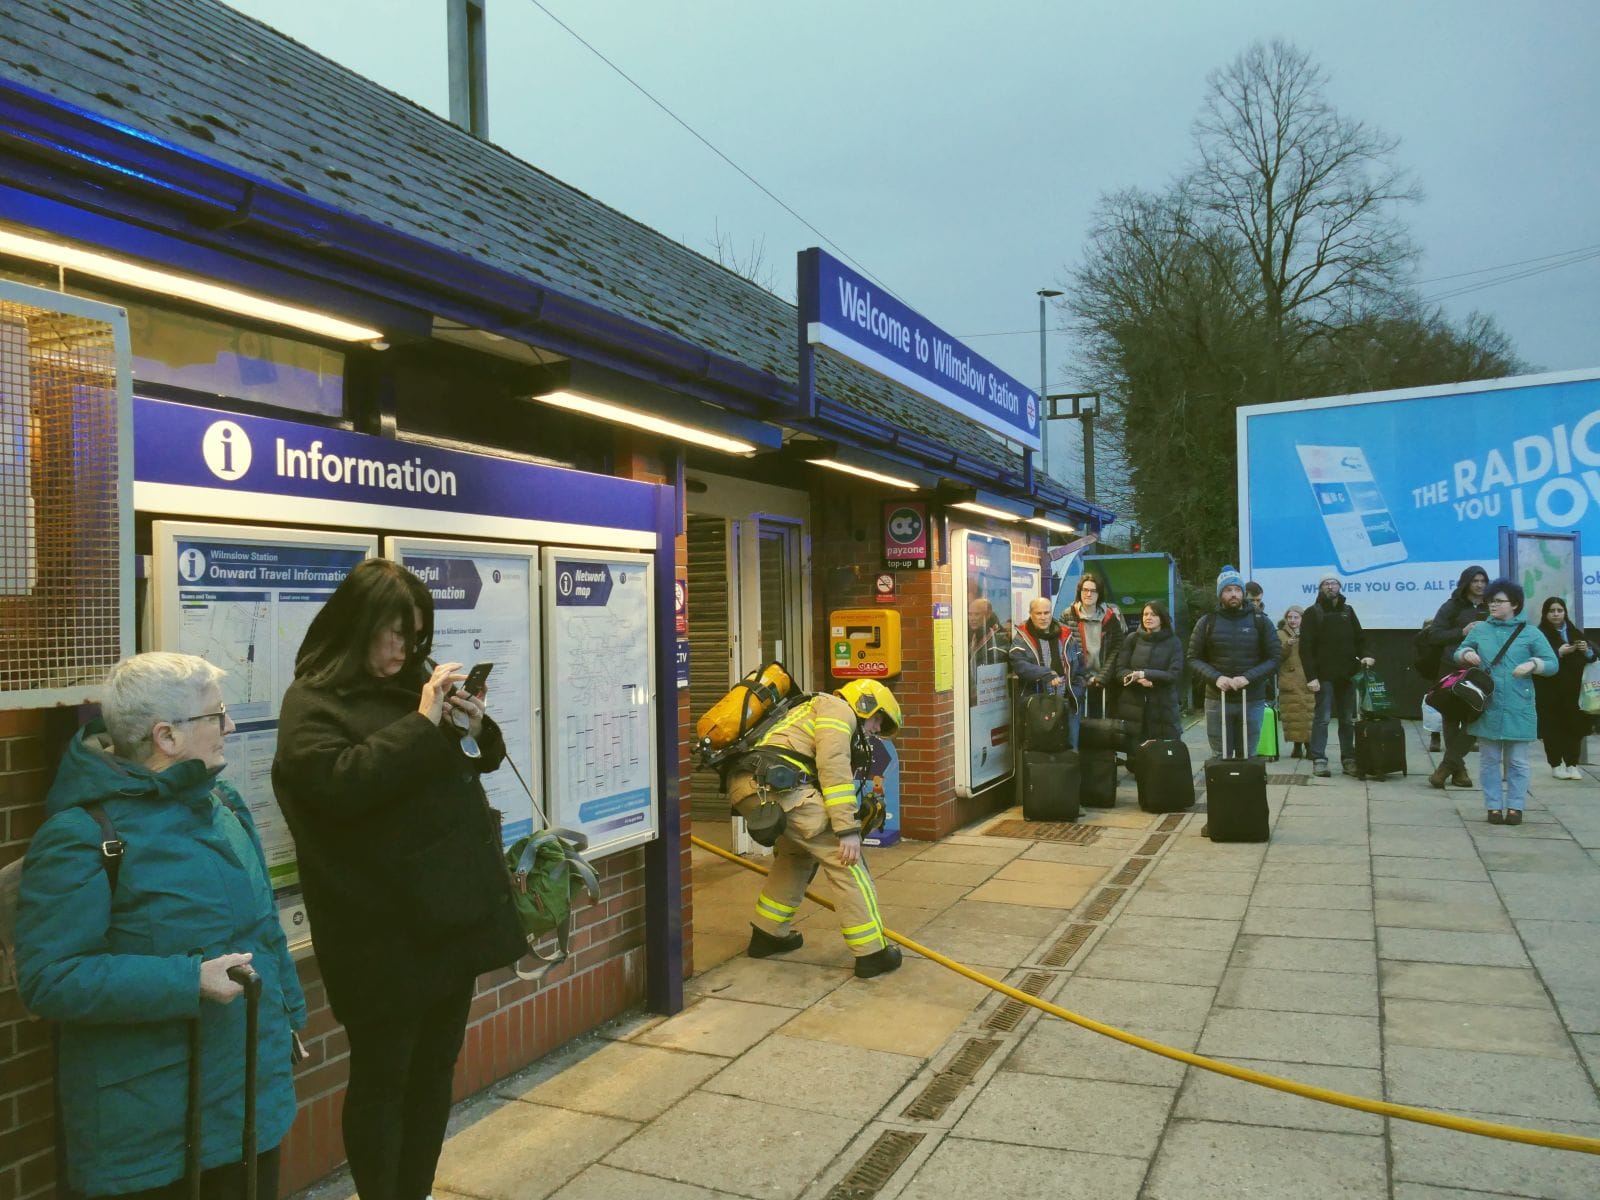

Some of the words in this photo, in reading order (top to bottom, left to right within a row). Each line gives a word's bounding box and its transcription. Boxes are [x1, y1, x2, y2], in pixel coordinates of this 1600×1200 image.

[838, 276, 911, 353] Welcome
[915, 328, 929, 363] to
[933, 337, 987, 396] Wilmslow
[988, 372, 1020, 416] Station
[275, 437, 458, 497] Information
[1412, 480, 1449, 508] THE
[1453, 493, 1500, 522] YOU
[210, 549, 249, 561] Wilmslow
[251, 551, 279, 562] Station
[887, 546, 925, 557] payzone
[887, 559, 912, 568] top-up
[210, 565, 257, 580] Onward
[259, 567, 292, 581] Travel
[293, 568, 348, 582] Informatio
[575, 569, 606, 582] Network
[575, 586, 591, 599] map
[1302, 582, 1362, 594] WHVER
[1364, 581, 1391, 592] YOU
[1395, 581, 1419, 592] GO.
[1423, 580, 1445, 591] ALL
